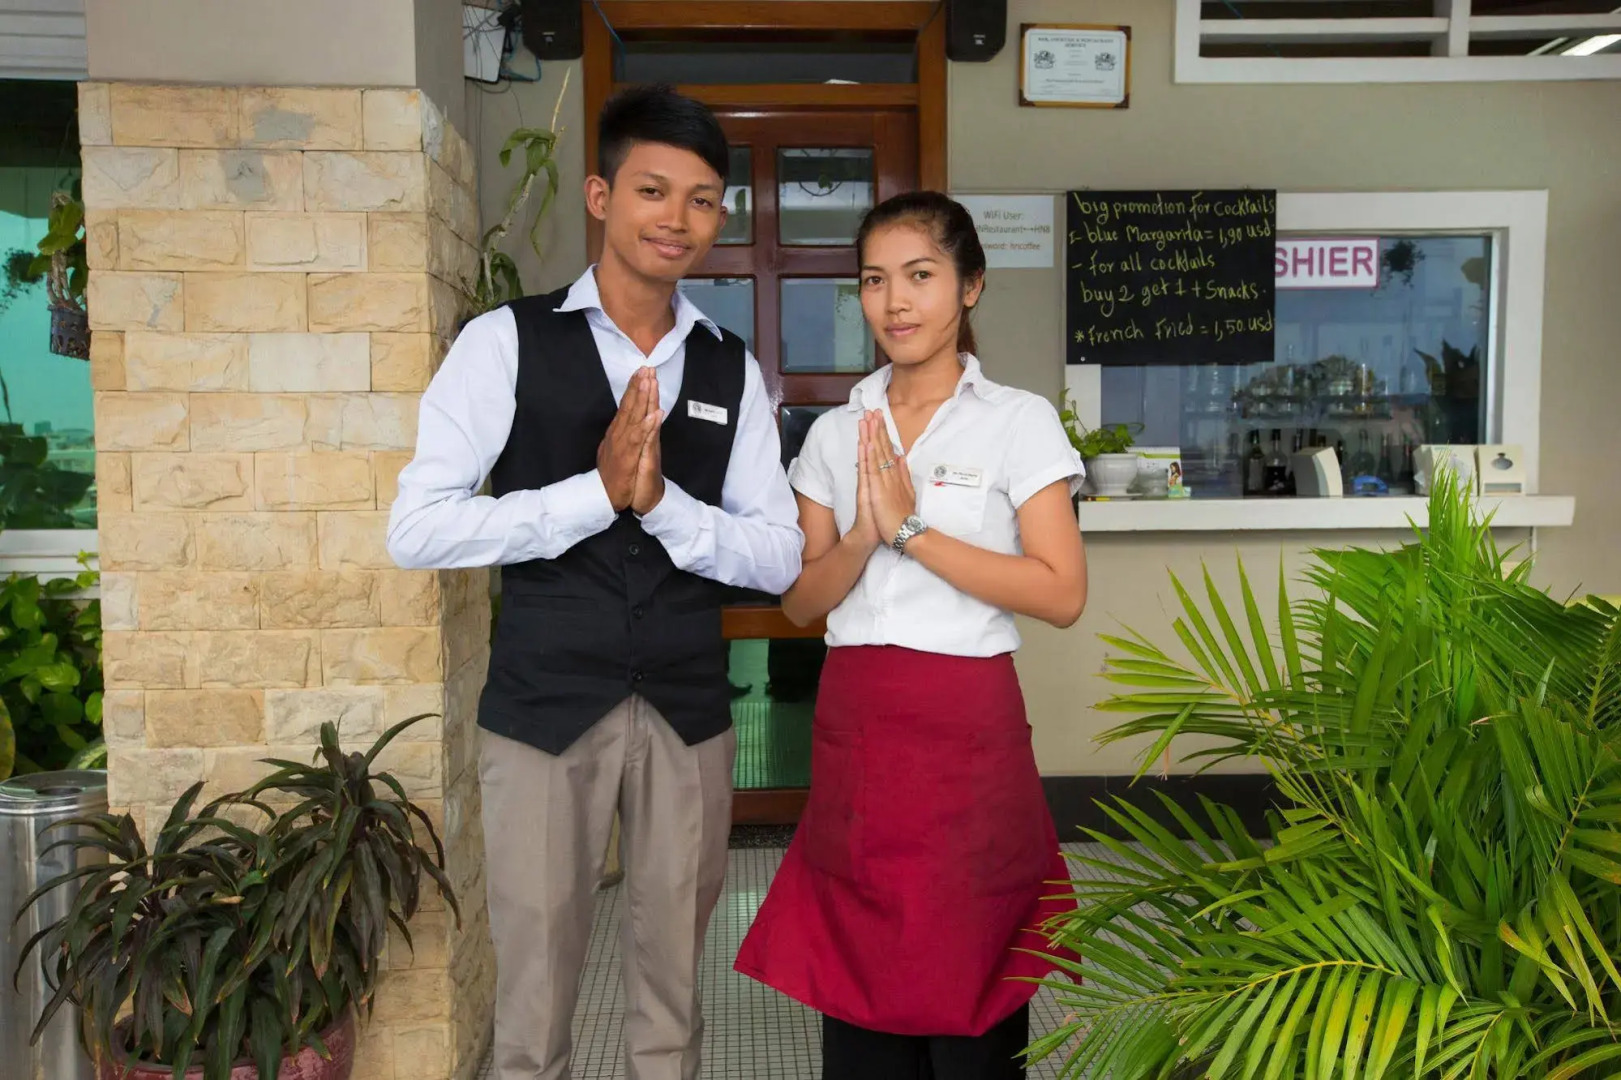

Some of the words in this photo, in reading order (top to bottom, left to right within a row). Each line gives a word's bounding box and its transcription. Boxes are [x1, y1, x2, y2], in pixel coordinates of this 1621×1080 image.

[1073, 191, 1109, 225] big
[1112, 192, 1186, 220] promotion
[1083, 220, 1118, 244] blue
[1120, 251, 1142, 272] all
[1080, 280, 1115, 318] buy
[1118, 285, 1135, 302] 2
[1141, 276, 1170, 307] get
